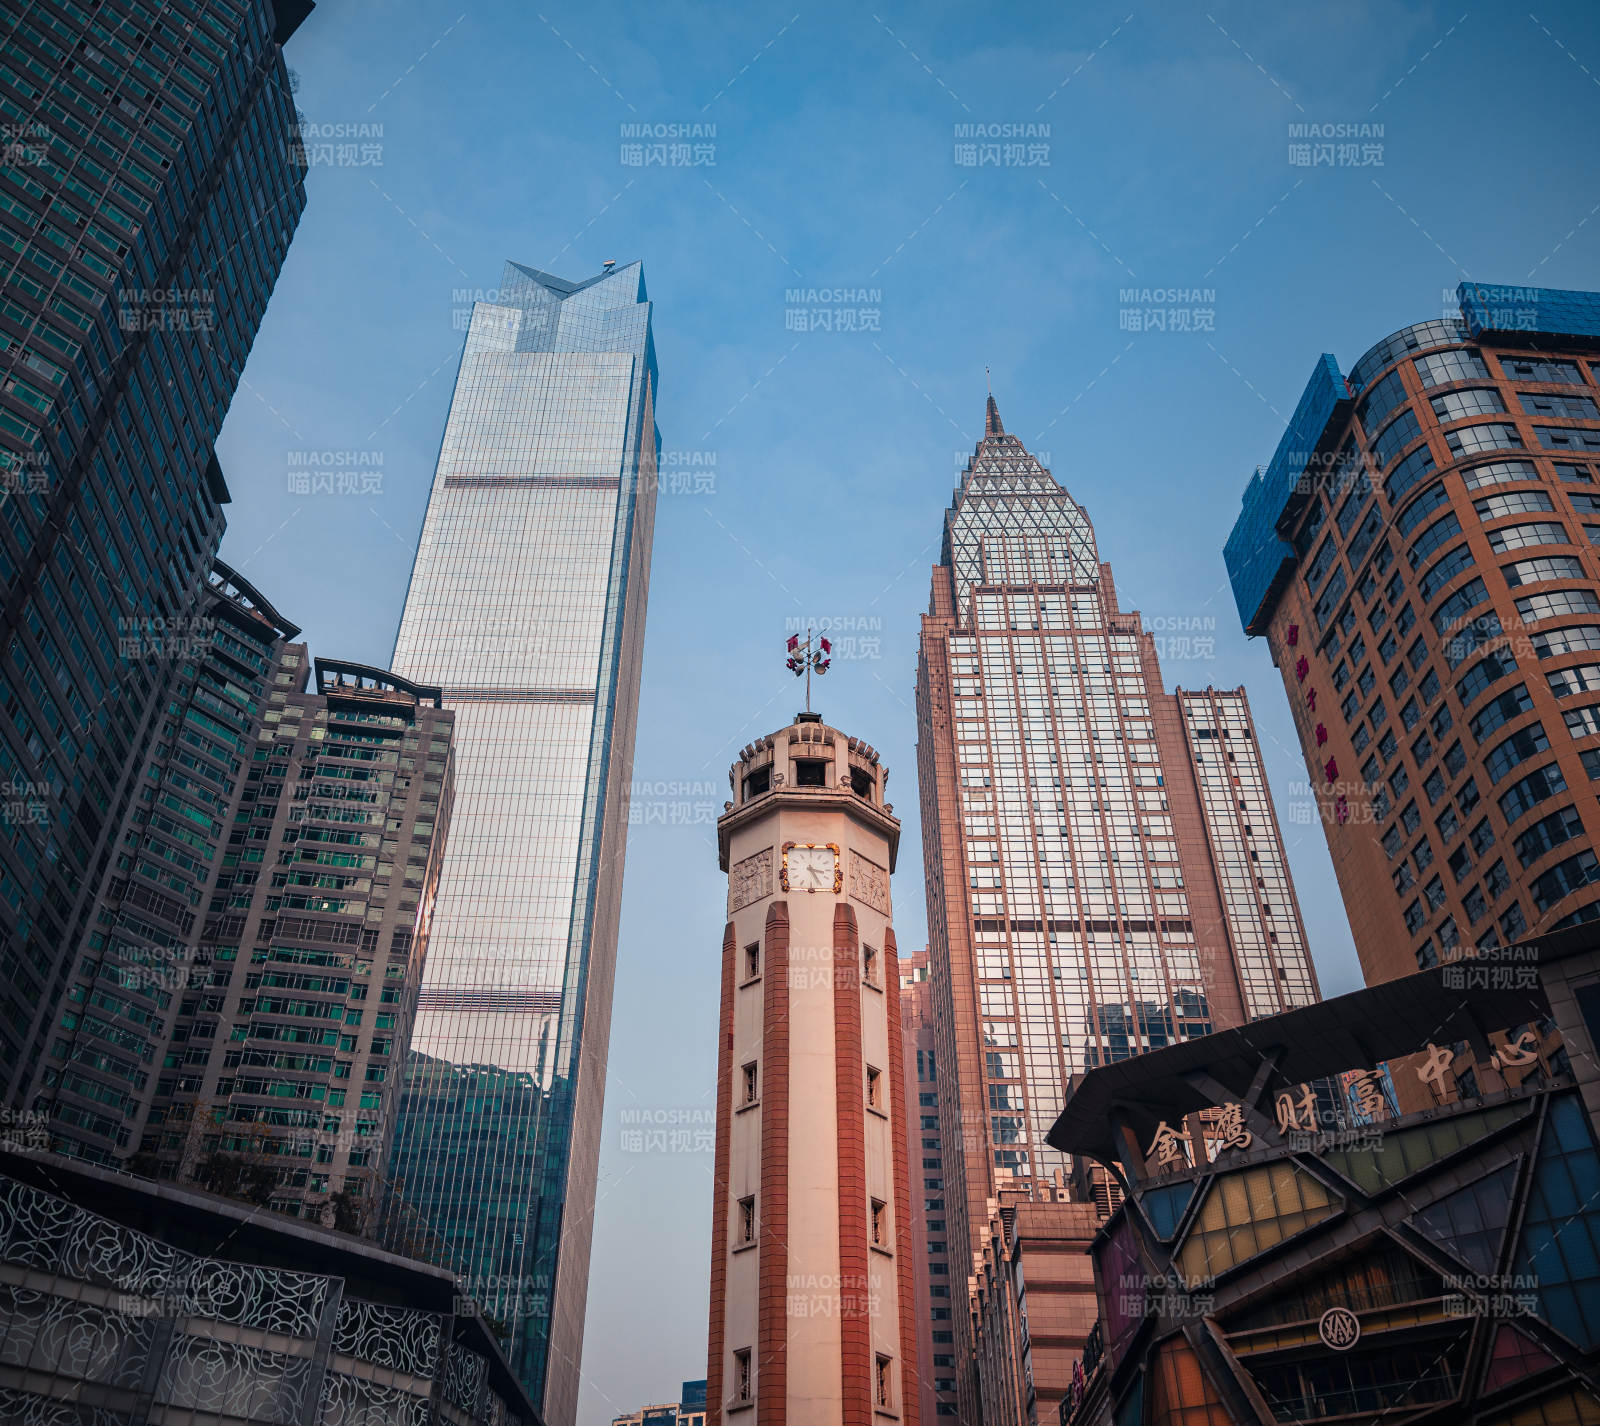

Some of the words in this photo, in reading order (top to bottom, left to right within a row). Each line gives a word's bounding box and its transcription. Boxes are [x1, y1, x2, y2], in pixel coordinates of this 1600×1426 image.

[1147, 1032, 1538, 1167] 金鹰财富中心
